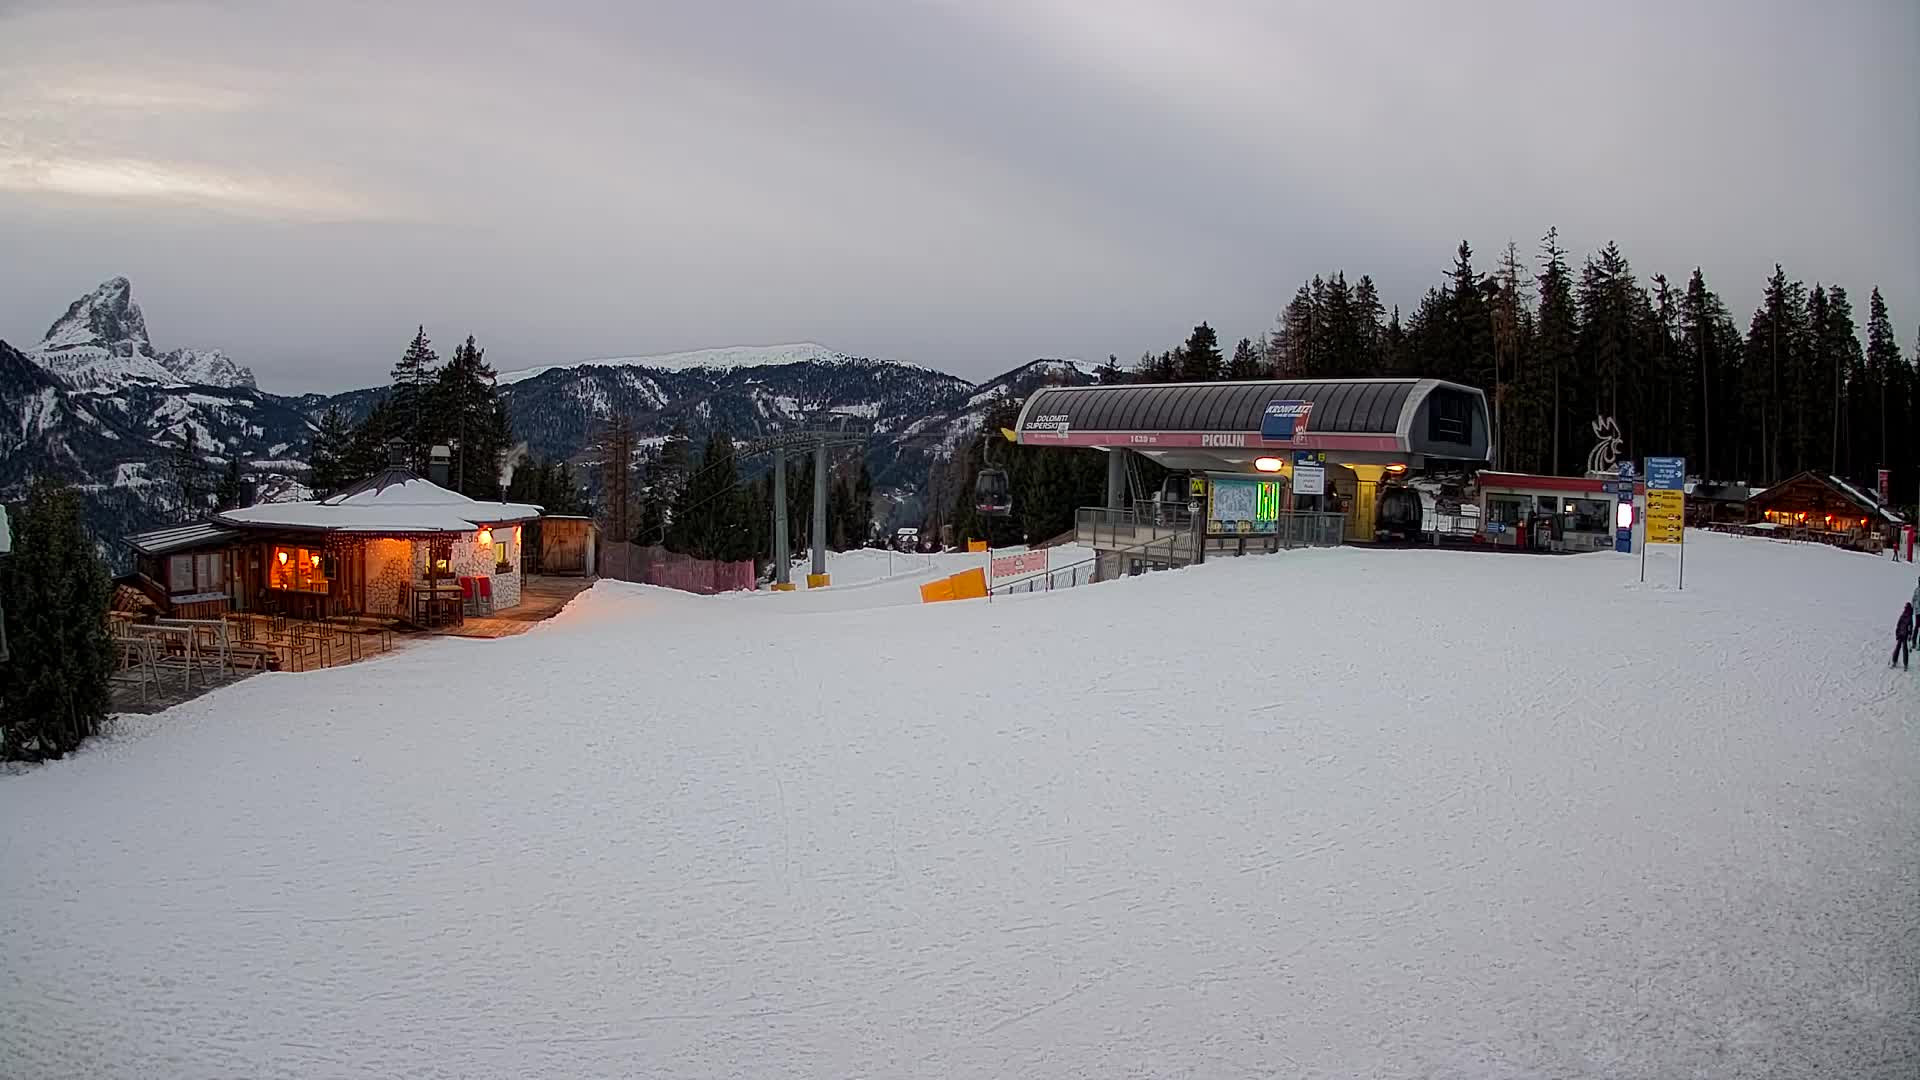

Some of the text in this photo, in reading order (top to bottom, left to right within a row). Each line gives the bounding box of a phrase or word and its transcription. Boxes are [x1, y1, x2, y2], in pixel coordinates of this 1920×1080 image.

[1264, 405, 1312, 414] KRONPLATZ
[1025, 422, 1059, 430] SUPERSKI
[1202, 434, 1245, 447] PICULIN
